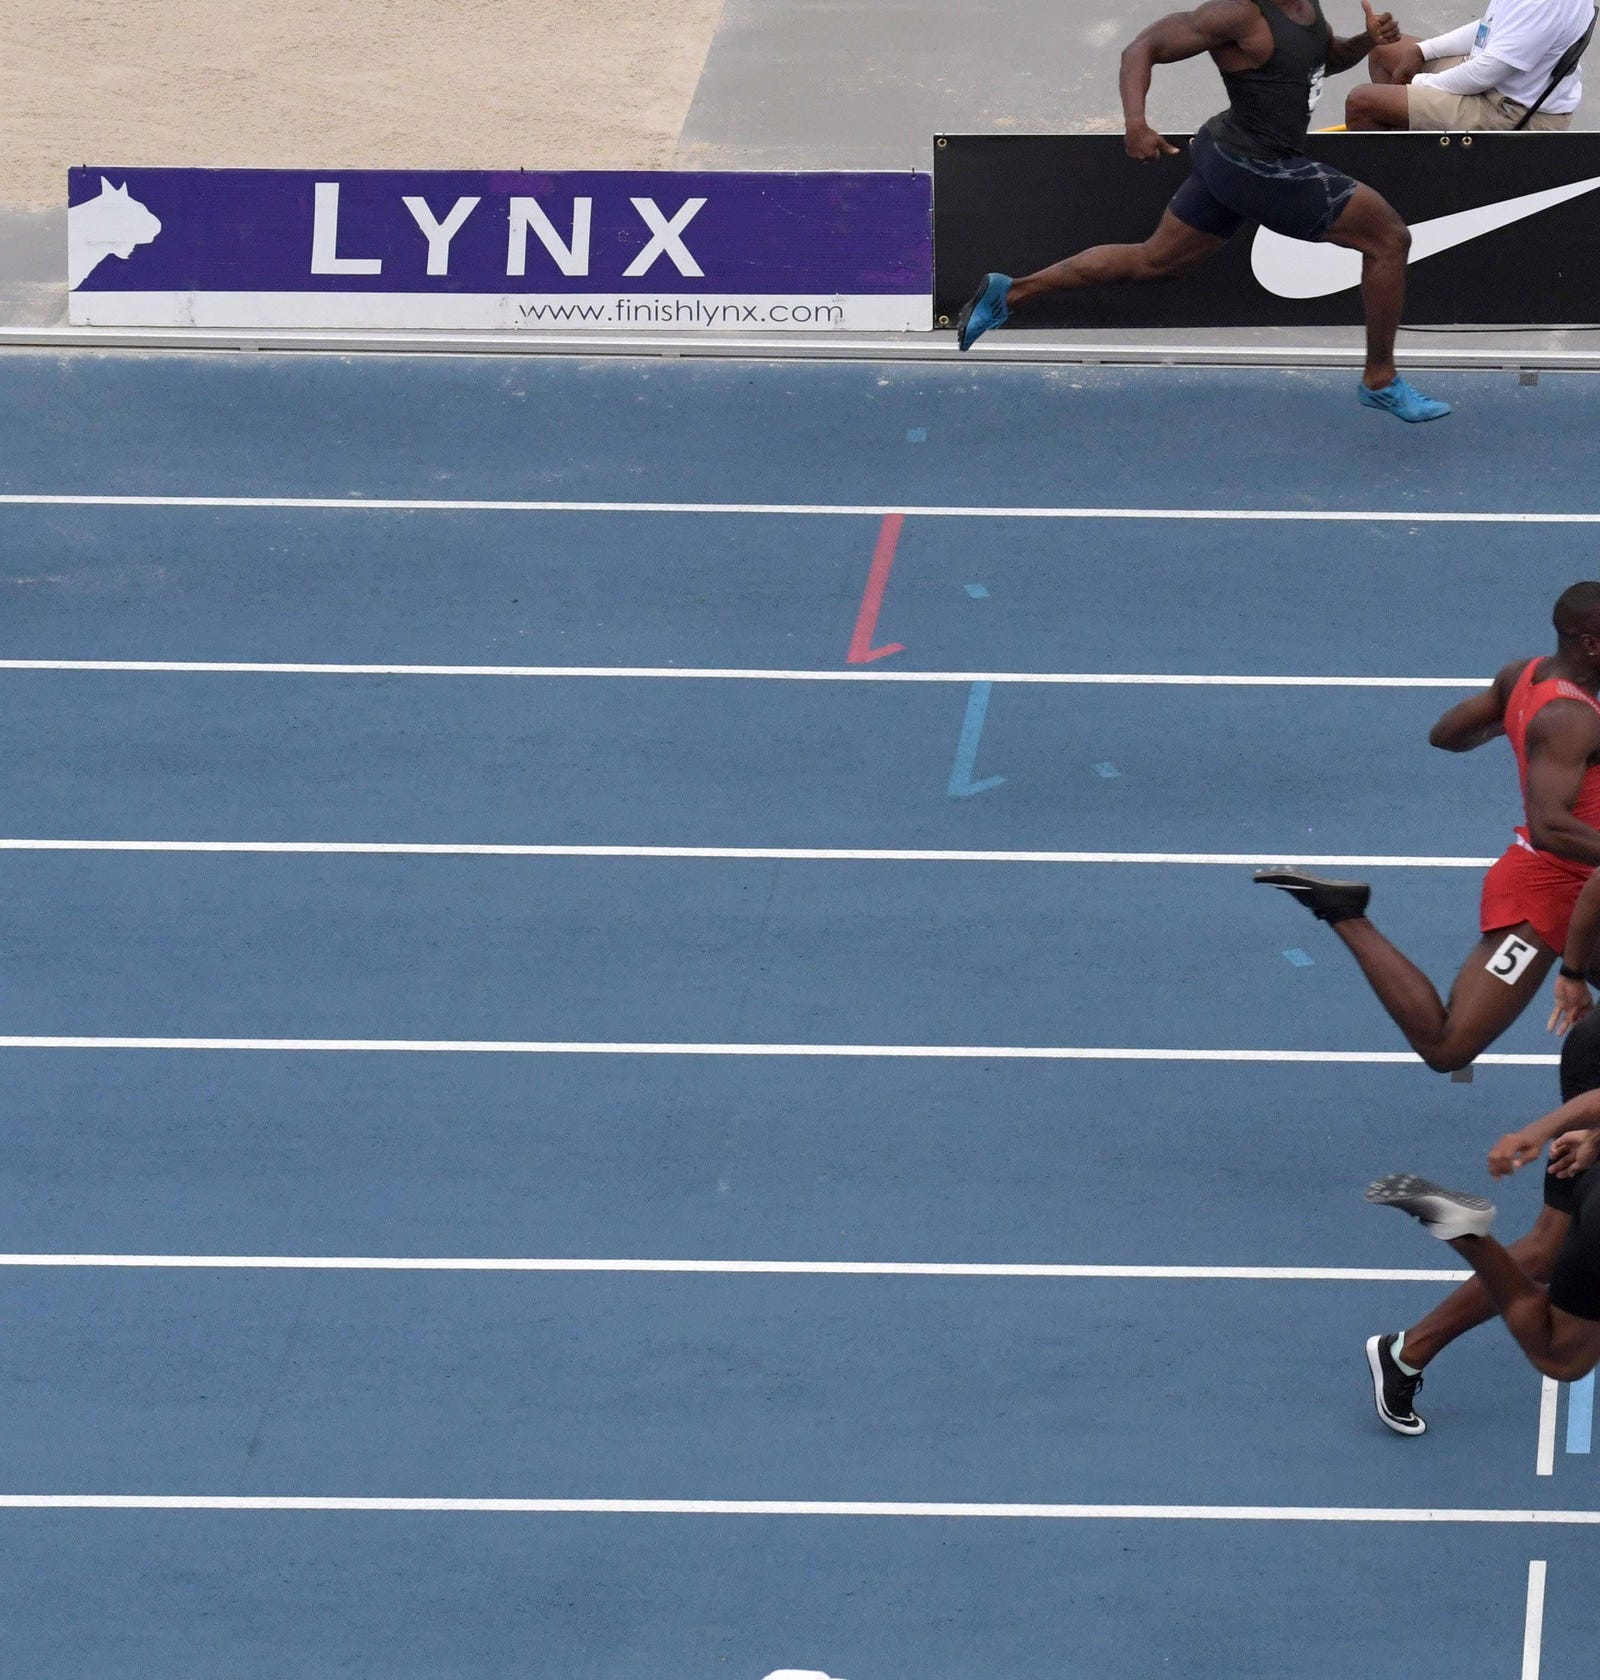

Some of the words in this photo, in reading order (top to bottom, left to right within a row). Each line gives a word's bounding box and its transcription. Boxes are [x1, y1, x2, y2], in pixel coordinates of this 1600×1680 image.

[310, 182, 708, 277] LYNX
[519, 299, 844, 327] www.finishlynx.com
[1493, 940, 1528, 977] 5
